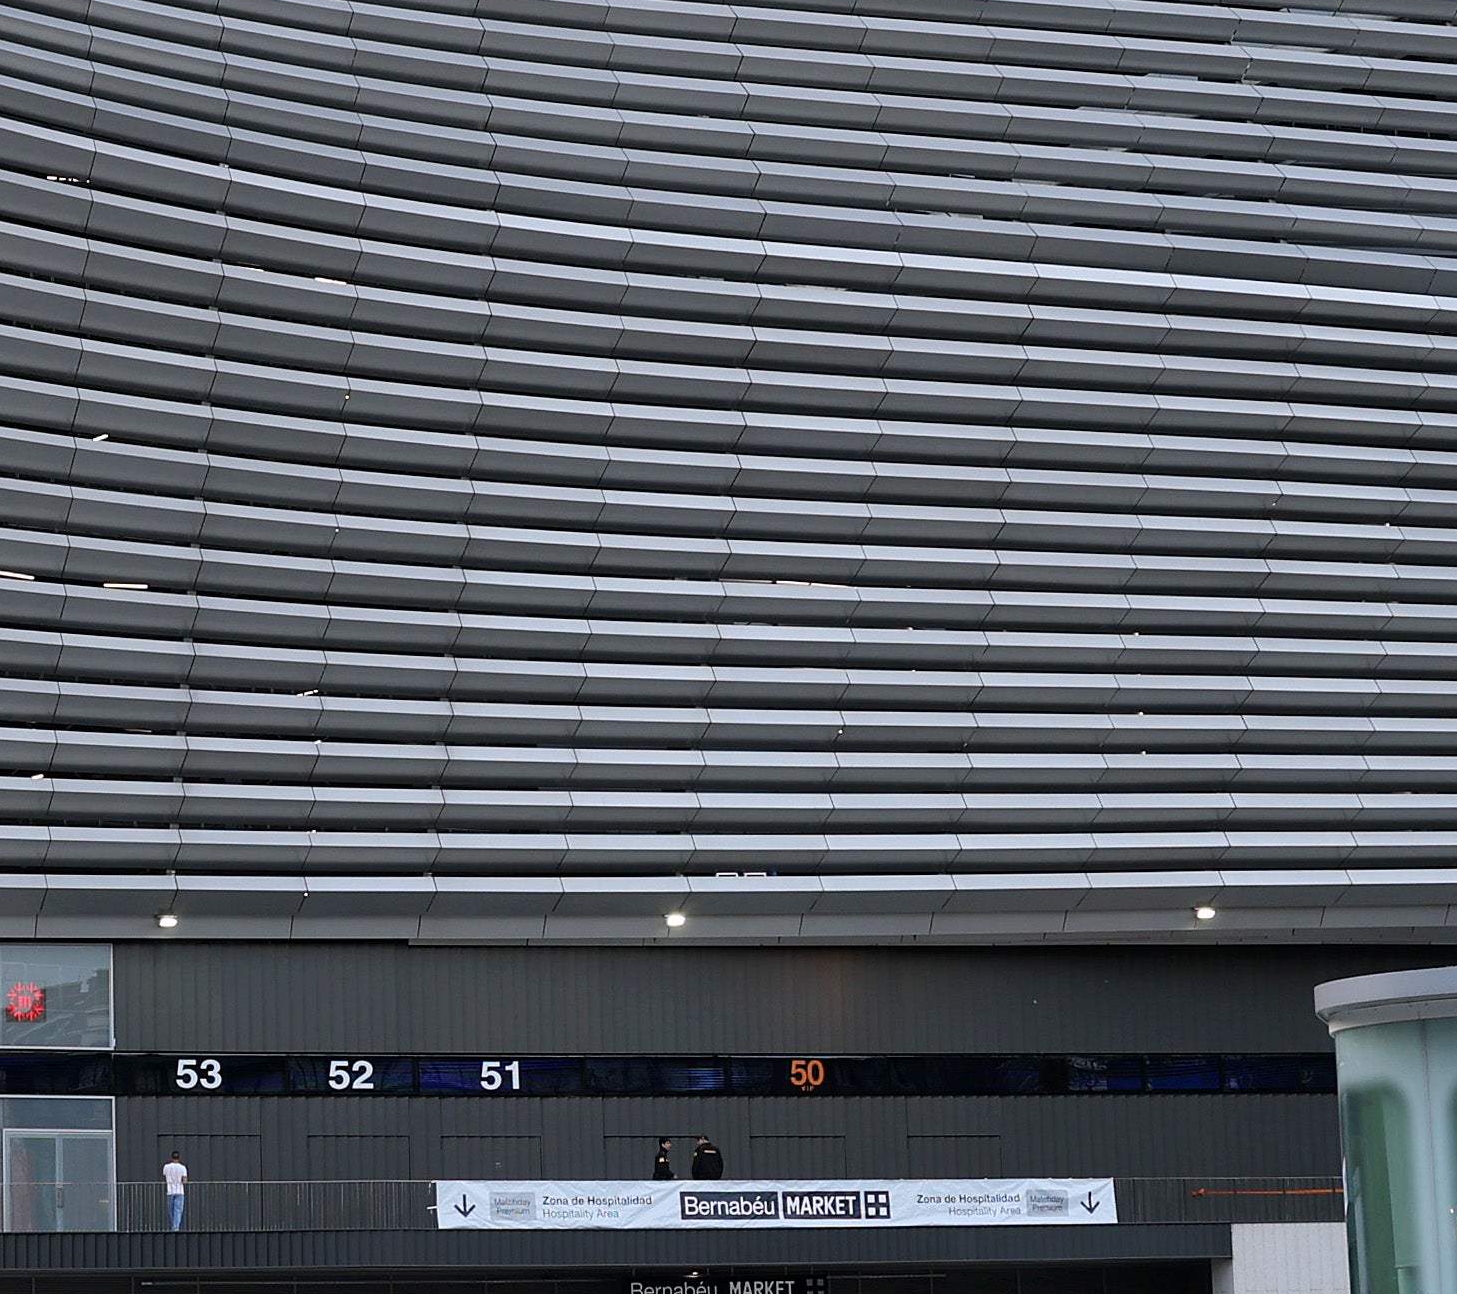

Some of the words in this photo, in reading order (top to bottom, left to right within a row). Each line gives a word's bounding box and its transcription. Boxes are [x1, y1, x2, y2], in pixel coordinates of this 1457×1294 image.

[175, 1058, 223, 1089] 53
[328, 1060, 375, 1090] 52
[480, 1061, 520, 1090] 51
[790, 1059, 825, 1086] 50
[542, 1196, 570, 1206] Zona
[572, 1196, 584, 1206] de
[587, 1195, 653, 1207] Hospitalidad
[684, 1195, 775, 1216] Bernabéu
[786, 1195, 856, 1216] MARKET
[917, 1194, 942, 1204] Zona
[944, 1194, 956, 1204] de
[959, 1193, 1021, 1206] Hospitalidad
[542, 1208, 595, 1219] Hospitality
[597, 1208, 620, 1218] Area
[948, 1206, 997, 1217] Hospitality
[1000, 1206, 1021, 1216] Area
